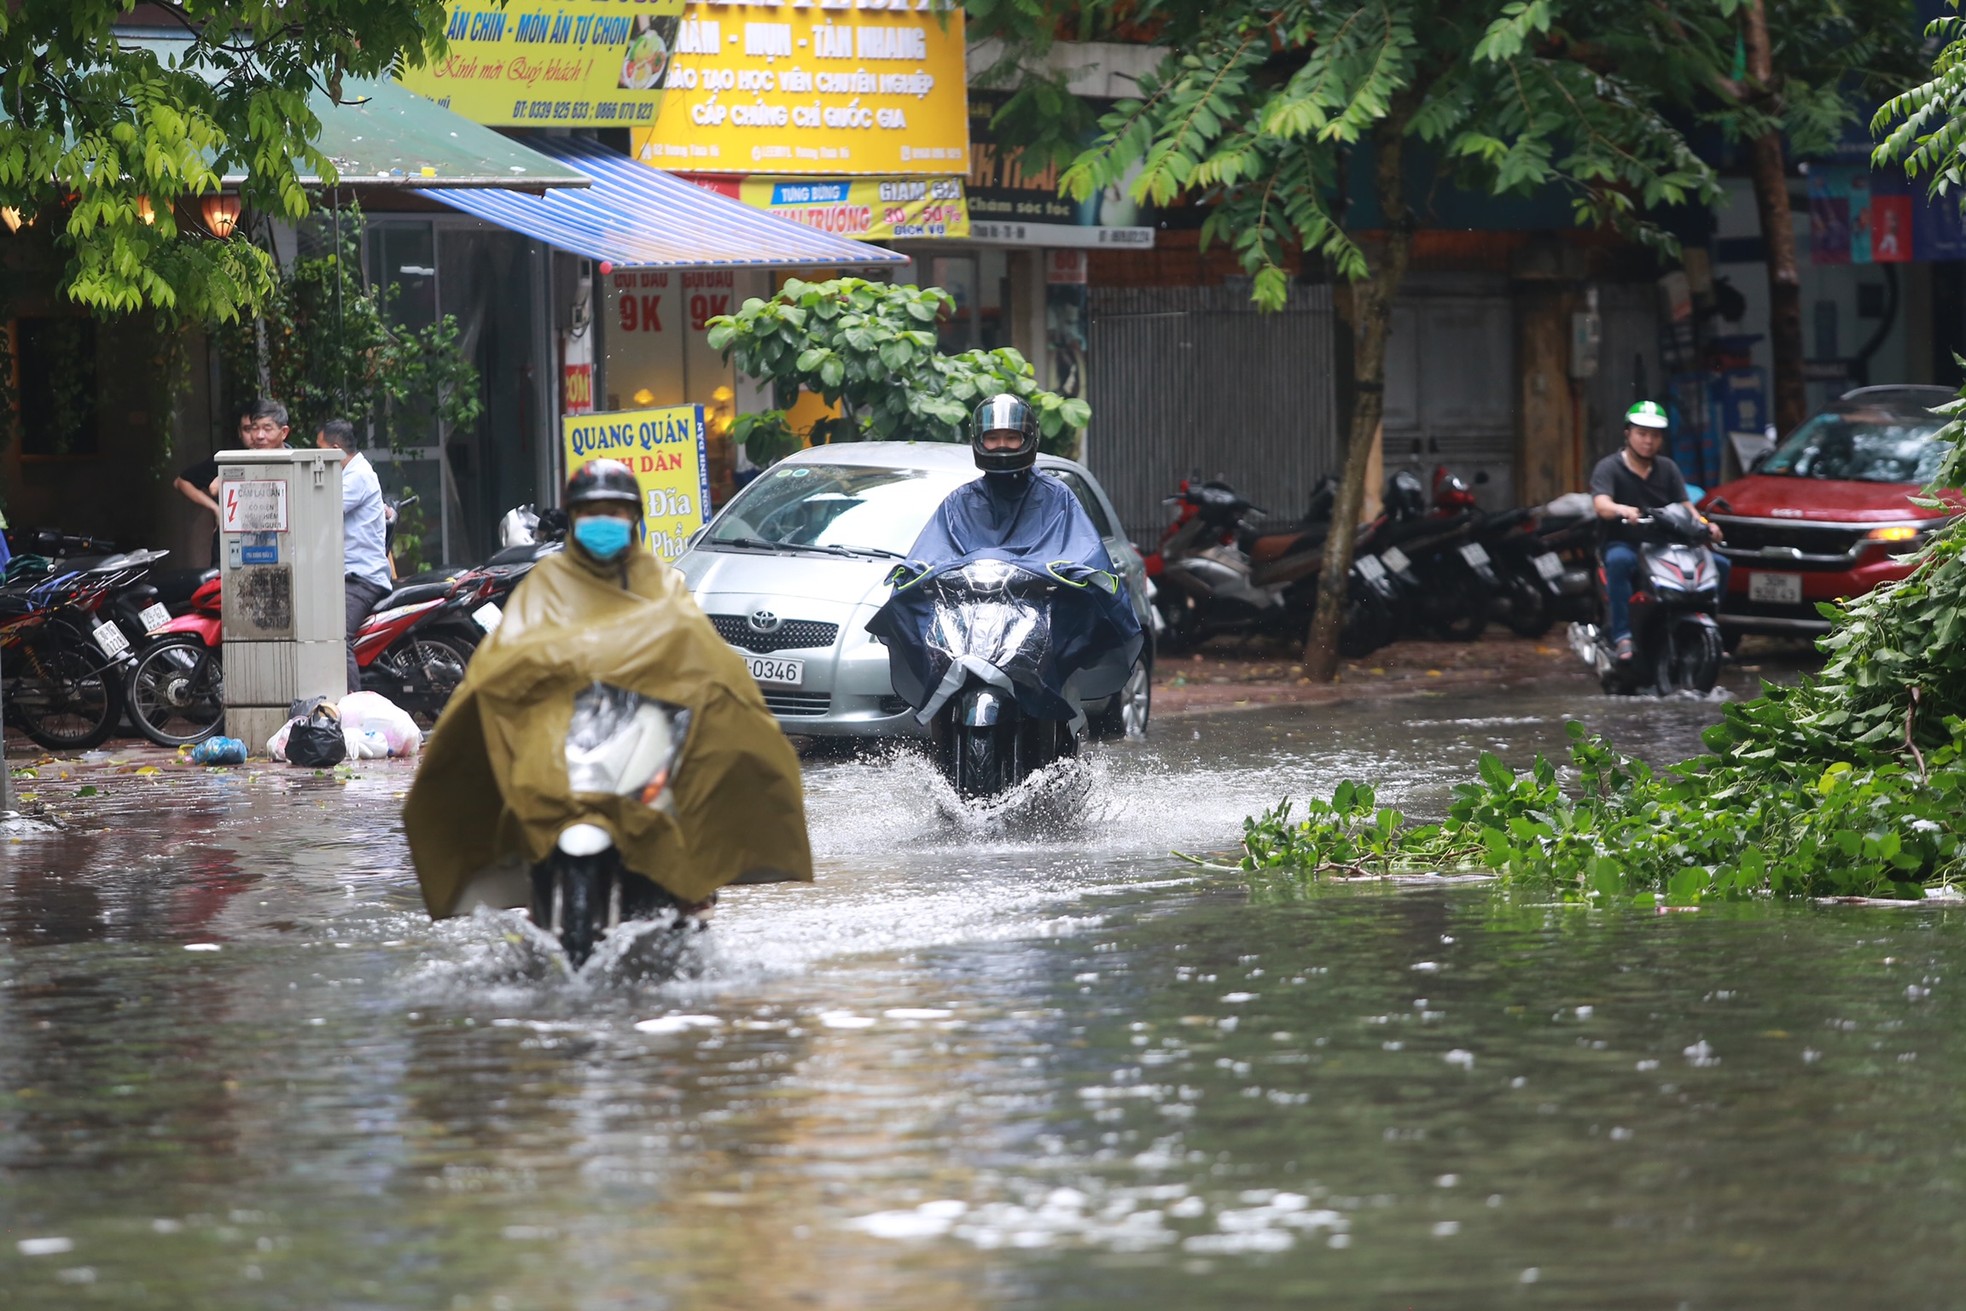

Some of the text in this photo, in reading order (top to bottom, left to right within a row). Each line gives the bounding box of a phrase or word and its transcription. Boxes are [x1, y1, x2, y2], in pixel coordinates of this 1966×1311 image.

[446, 6, 470, 40] ĂN
[470, 7, 507, 42] CHÍN
[514, 8, 551, 43] MÓN
[549, 10, 573, 44] ĂN
[573, 12, 595, 51] TỰ
[592, 16, 632, 51] CHỌN
[745, 23, 792, 63] MỤN
[812, 18, 852, 58] TÀN
[857, 26, 926, 59] NHANG
[507, 56, 544, 88] Quý
[543, 58, 581, 82] khách
[701, 68, 735, 94] TẠO
[737, 69, 774, 96] HỌC
[778, 66, 813, 92] VIÊN
[815, 68, 877, 94] CHUYÊN
[879, 69, 935, 99] NGHIỆP
[692, 95, 907, 129] CẤP CHỨNG CHỈ QUỐC GIA
[930, 177, 961, 199] GIÁ
[884, 207, 906, 224] 30
[619, 294, 662, 332] 9K
[572, 413, 689, 457] QUANG QUÁN
[696, 421, 706, 451] DÂN
[640, 449, 682, 473] DÂN
[647, 486, 692, 518] Đĩa
